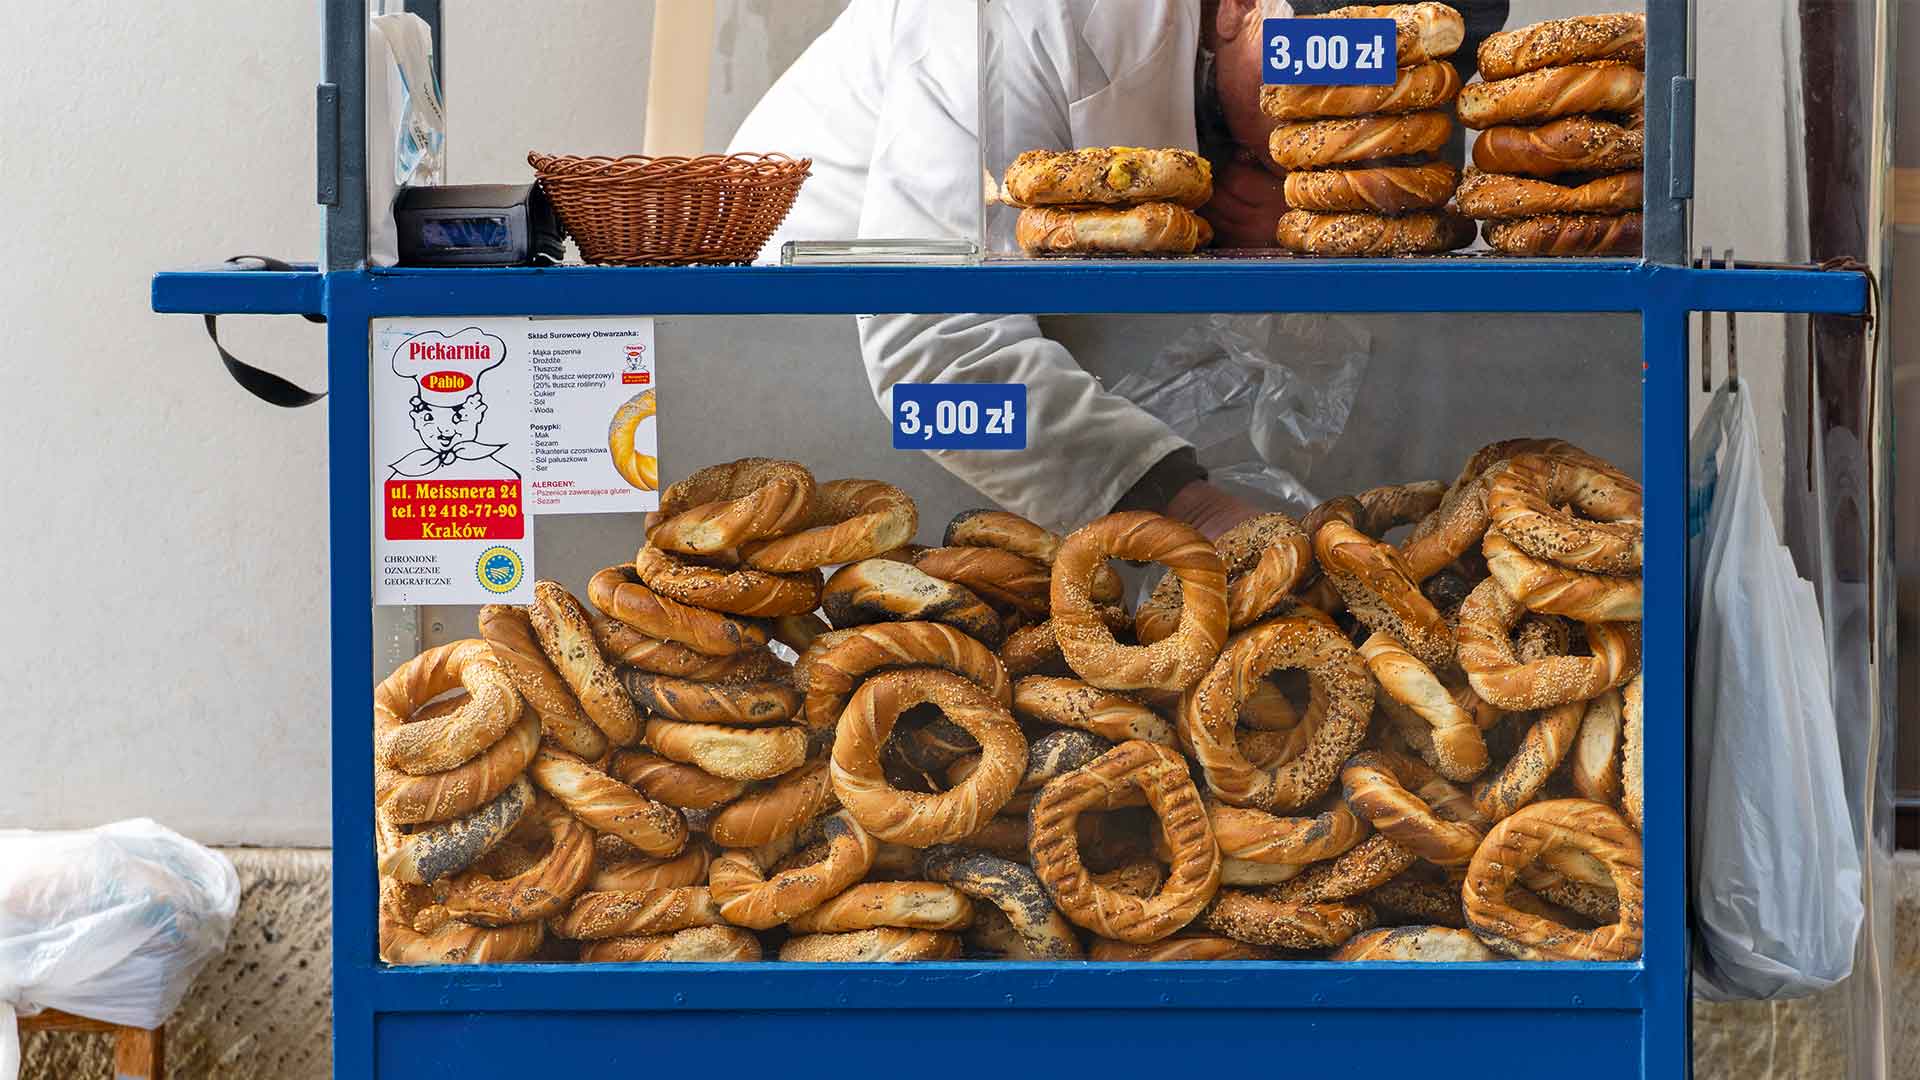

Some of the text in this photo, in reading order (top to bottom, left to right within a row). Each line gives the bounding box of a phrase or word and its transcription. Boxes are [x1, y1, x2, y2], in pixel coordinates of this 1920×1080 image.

[1270, 35, 1384, 76] 3,00 zł
[410, 342, 490, 360] Piekarnia
[430, 376, 464, 389] Pablo
[900, 400, 1015, 440] 3,00 zł
[391, 484, 518, 499] ul. Meissnera 24
[392, 504, 518, 518] tel. 12 418-77-90
[422, 522, 488, 538] Kraków
[384, 555, 438, 563] CHRONIONE
[384, 566, 440, 574] OZNACZENIE
[384, 578, 452, 586] GEOGRAFICZNE
